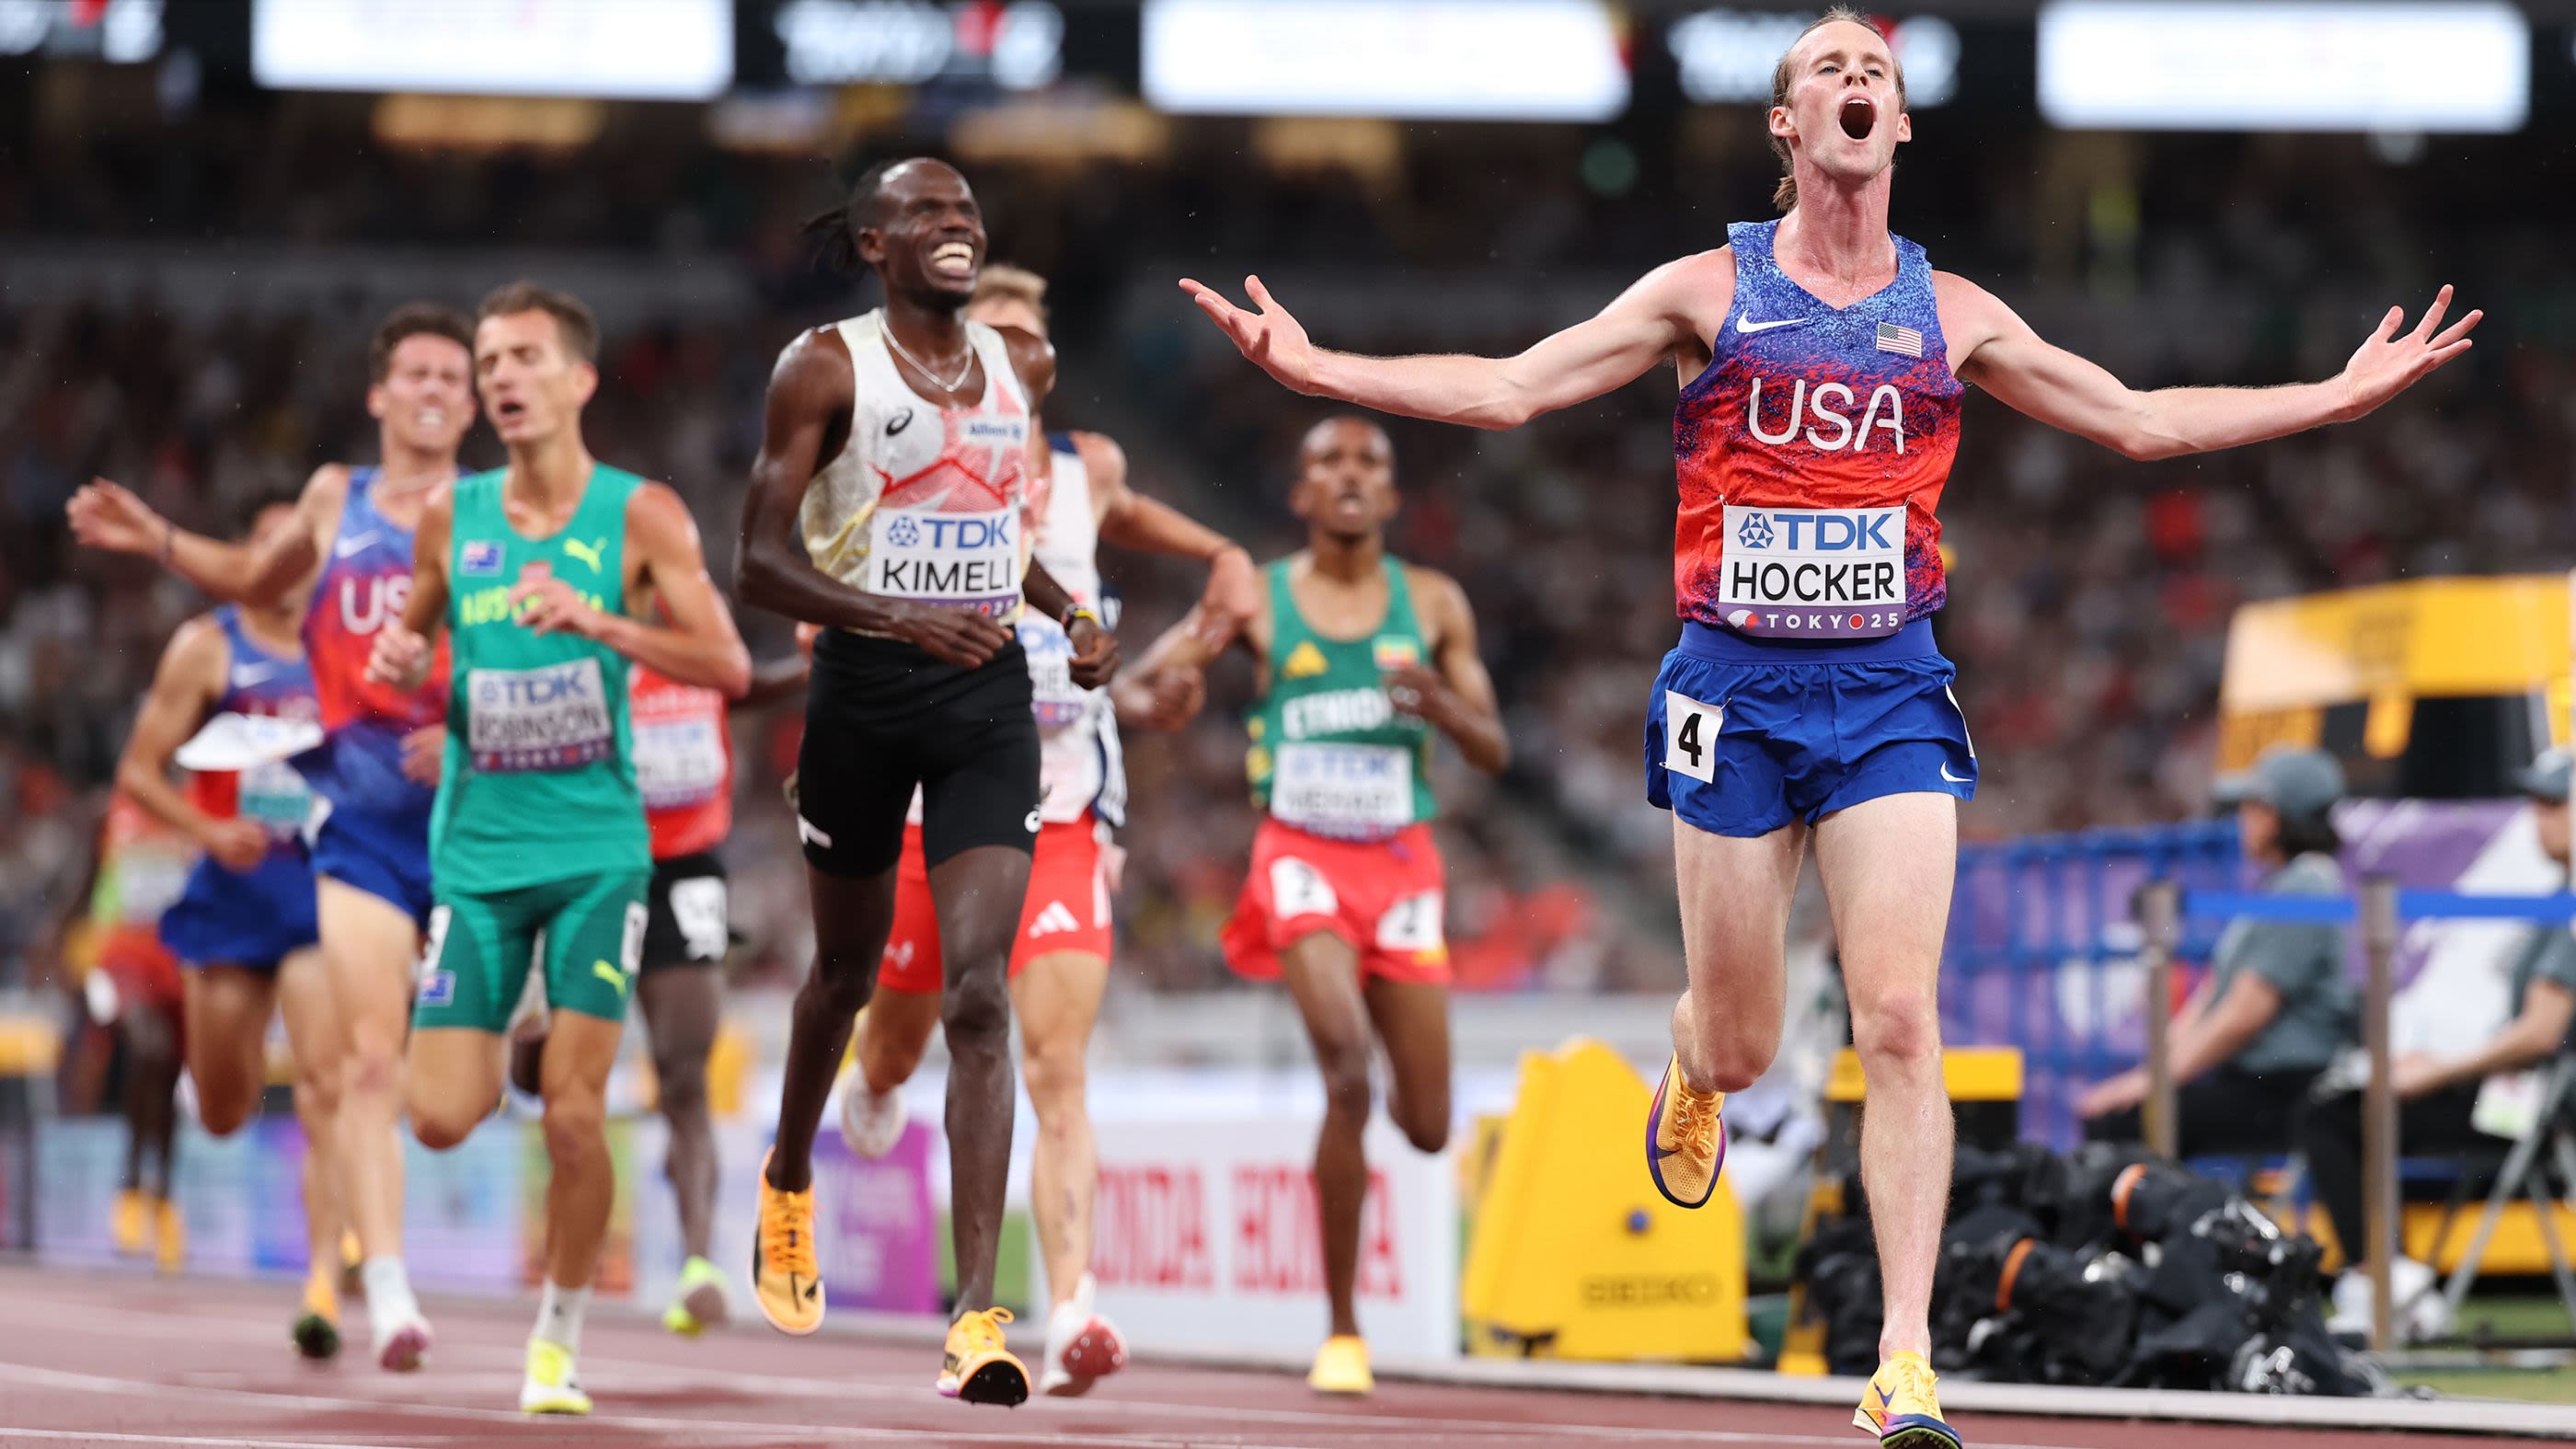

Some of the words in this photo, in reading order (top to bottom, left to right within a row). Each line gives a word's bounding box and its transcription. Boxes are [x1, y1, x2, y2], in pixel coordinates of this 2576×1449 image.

[1748, 376, 1904, 454] USA
[922, 515, 1009, 549] TDK
[1774, 512, 1893, 550] TDK
[881, 558, 1011, 593] KIMELI
[1731, 561, 1895, 603] HOCKER
[500, 669, 587, 706] TDK
[477, 703, 604, 743] ROBINSON
[1282, 686, 1397, 739] ETHIO
[1677, 713, 1703, 768] 4
